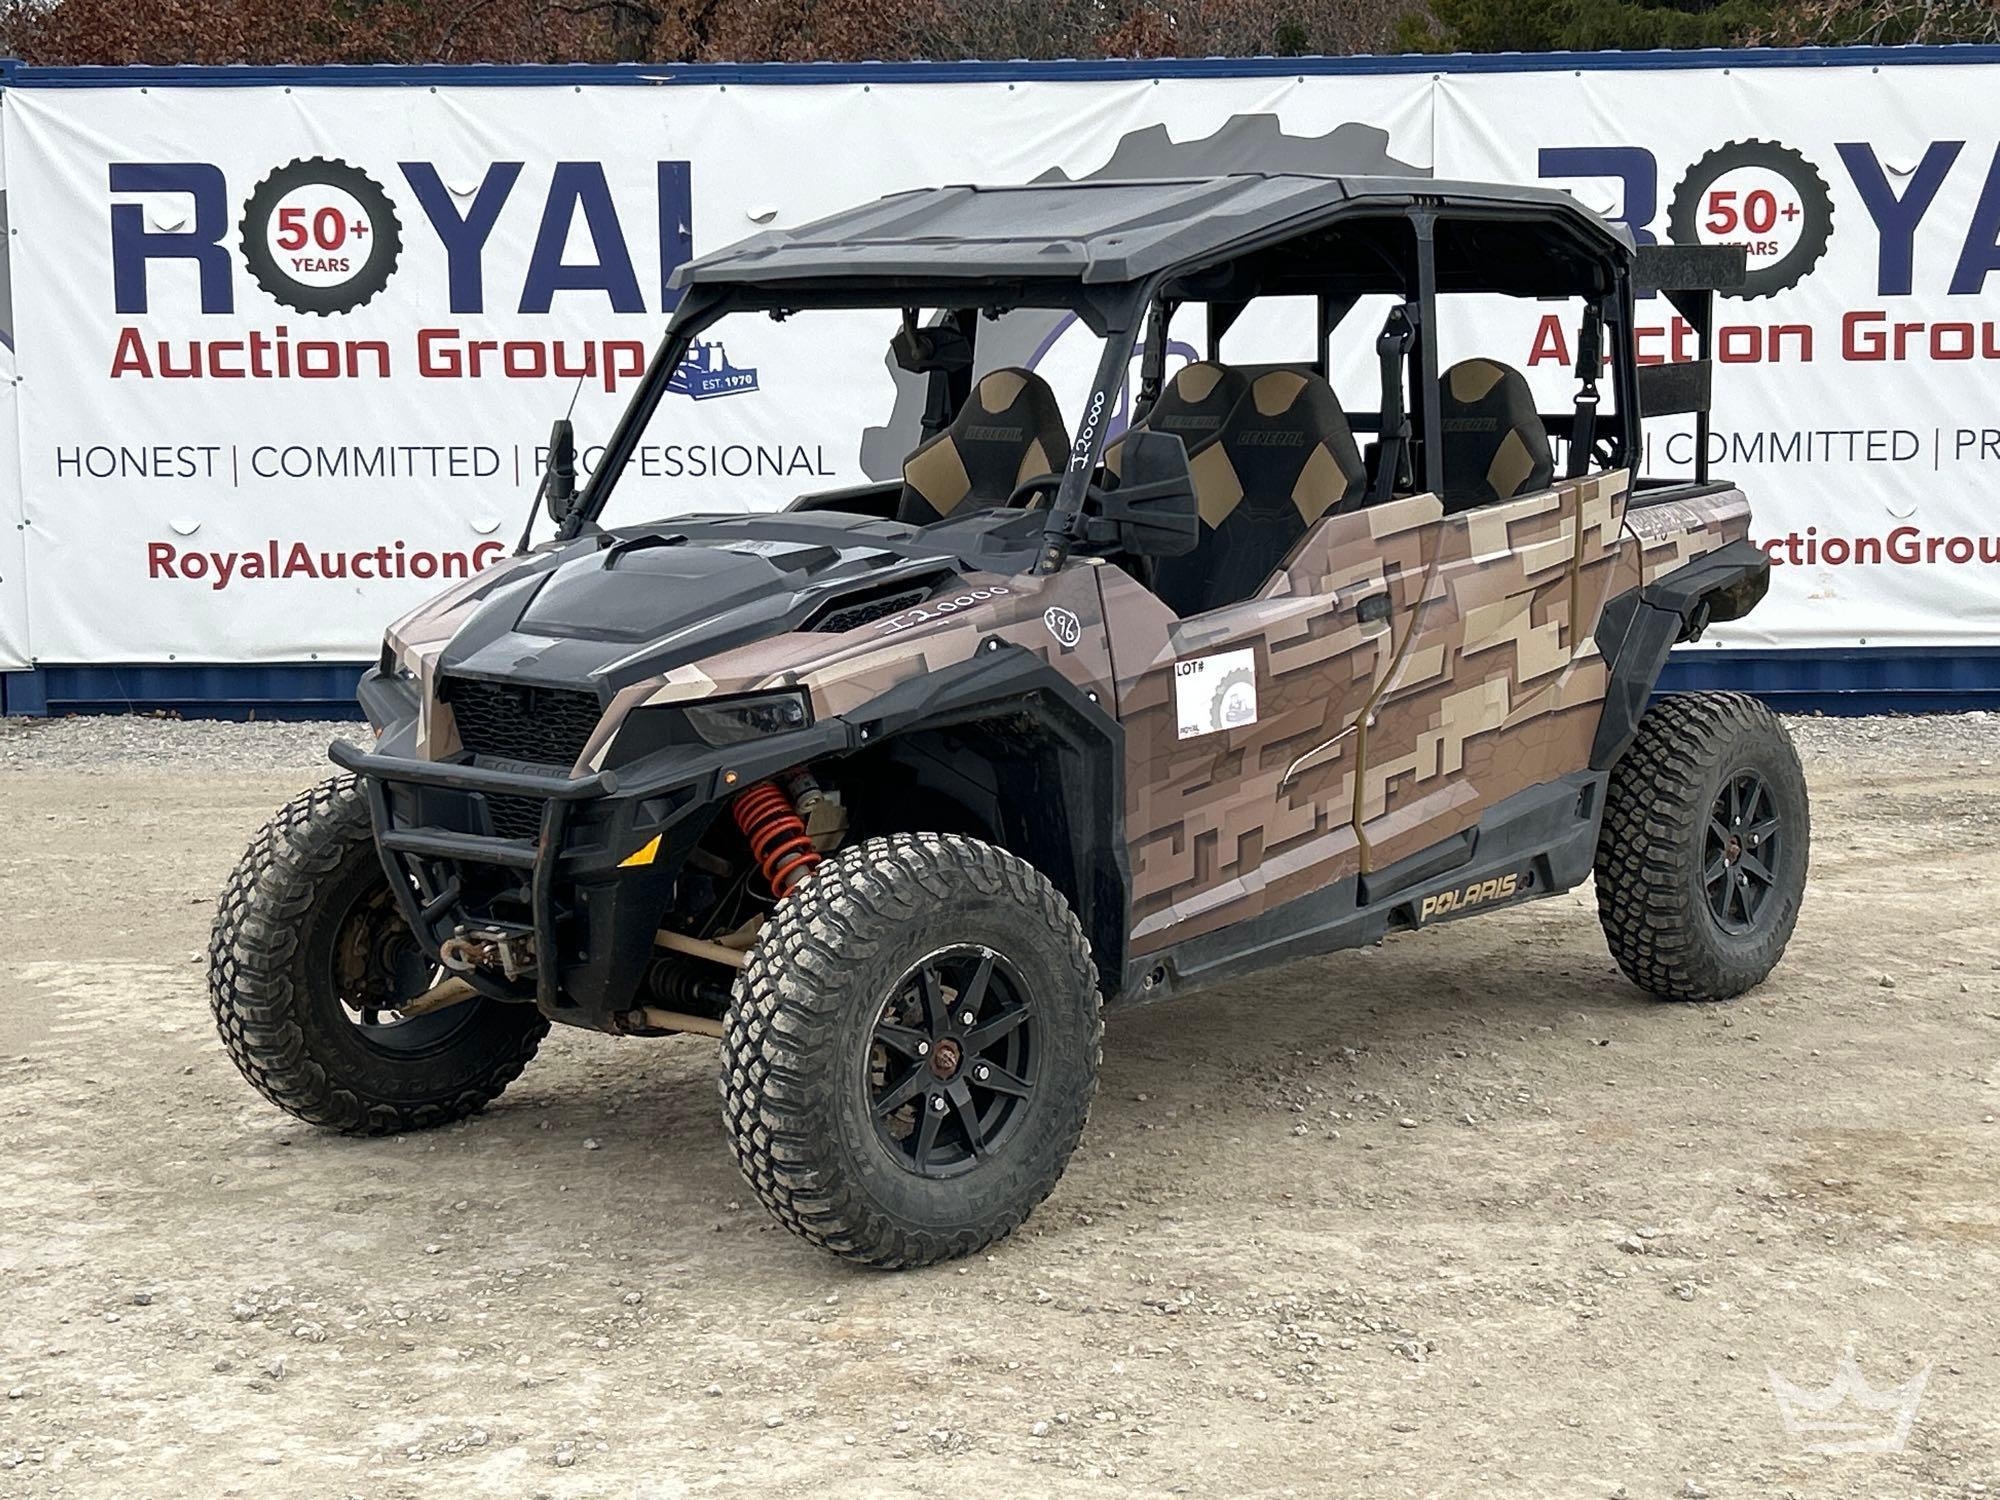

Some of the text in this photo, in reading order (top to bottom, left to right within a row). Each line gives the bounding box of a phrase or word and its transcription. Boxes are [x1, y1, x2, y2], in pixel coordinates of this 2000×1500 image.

[276, 206, 369, 252] 50+
[1705, 189, 1800, 234] 50+
[291, 257, 351, 274] YEARS
[1527, 313, 1813, 367] Acton
[110, 326, 646, 393] Auction Group
[702, 374, 753, 390] EST. 1970
[1237, 431, 1304, 446] GENERAL
[1666, 430, 1920, 465] COMMITTED
[56, 444, 836, 478] HONEST COMMITTED POESSIONAL
[1747, 526, 2000, 567] ctionGrou
[1046, 610, 1075, 641] 396
[1176, 660, 1205, 677] LOT#
[1420, 873, 1518, 923] POLARIS
